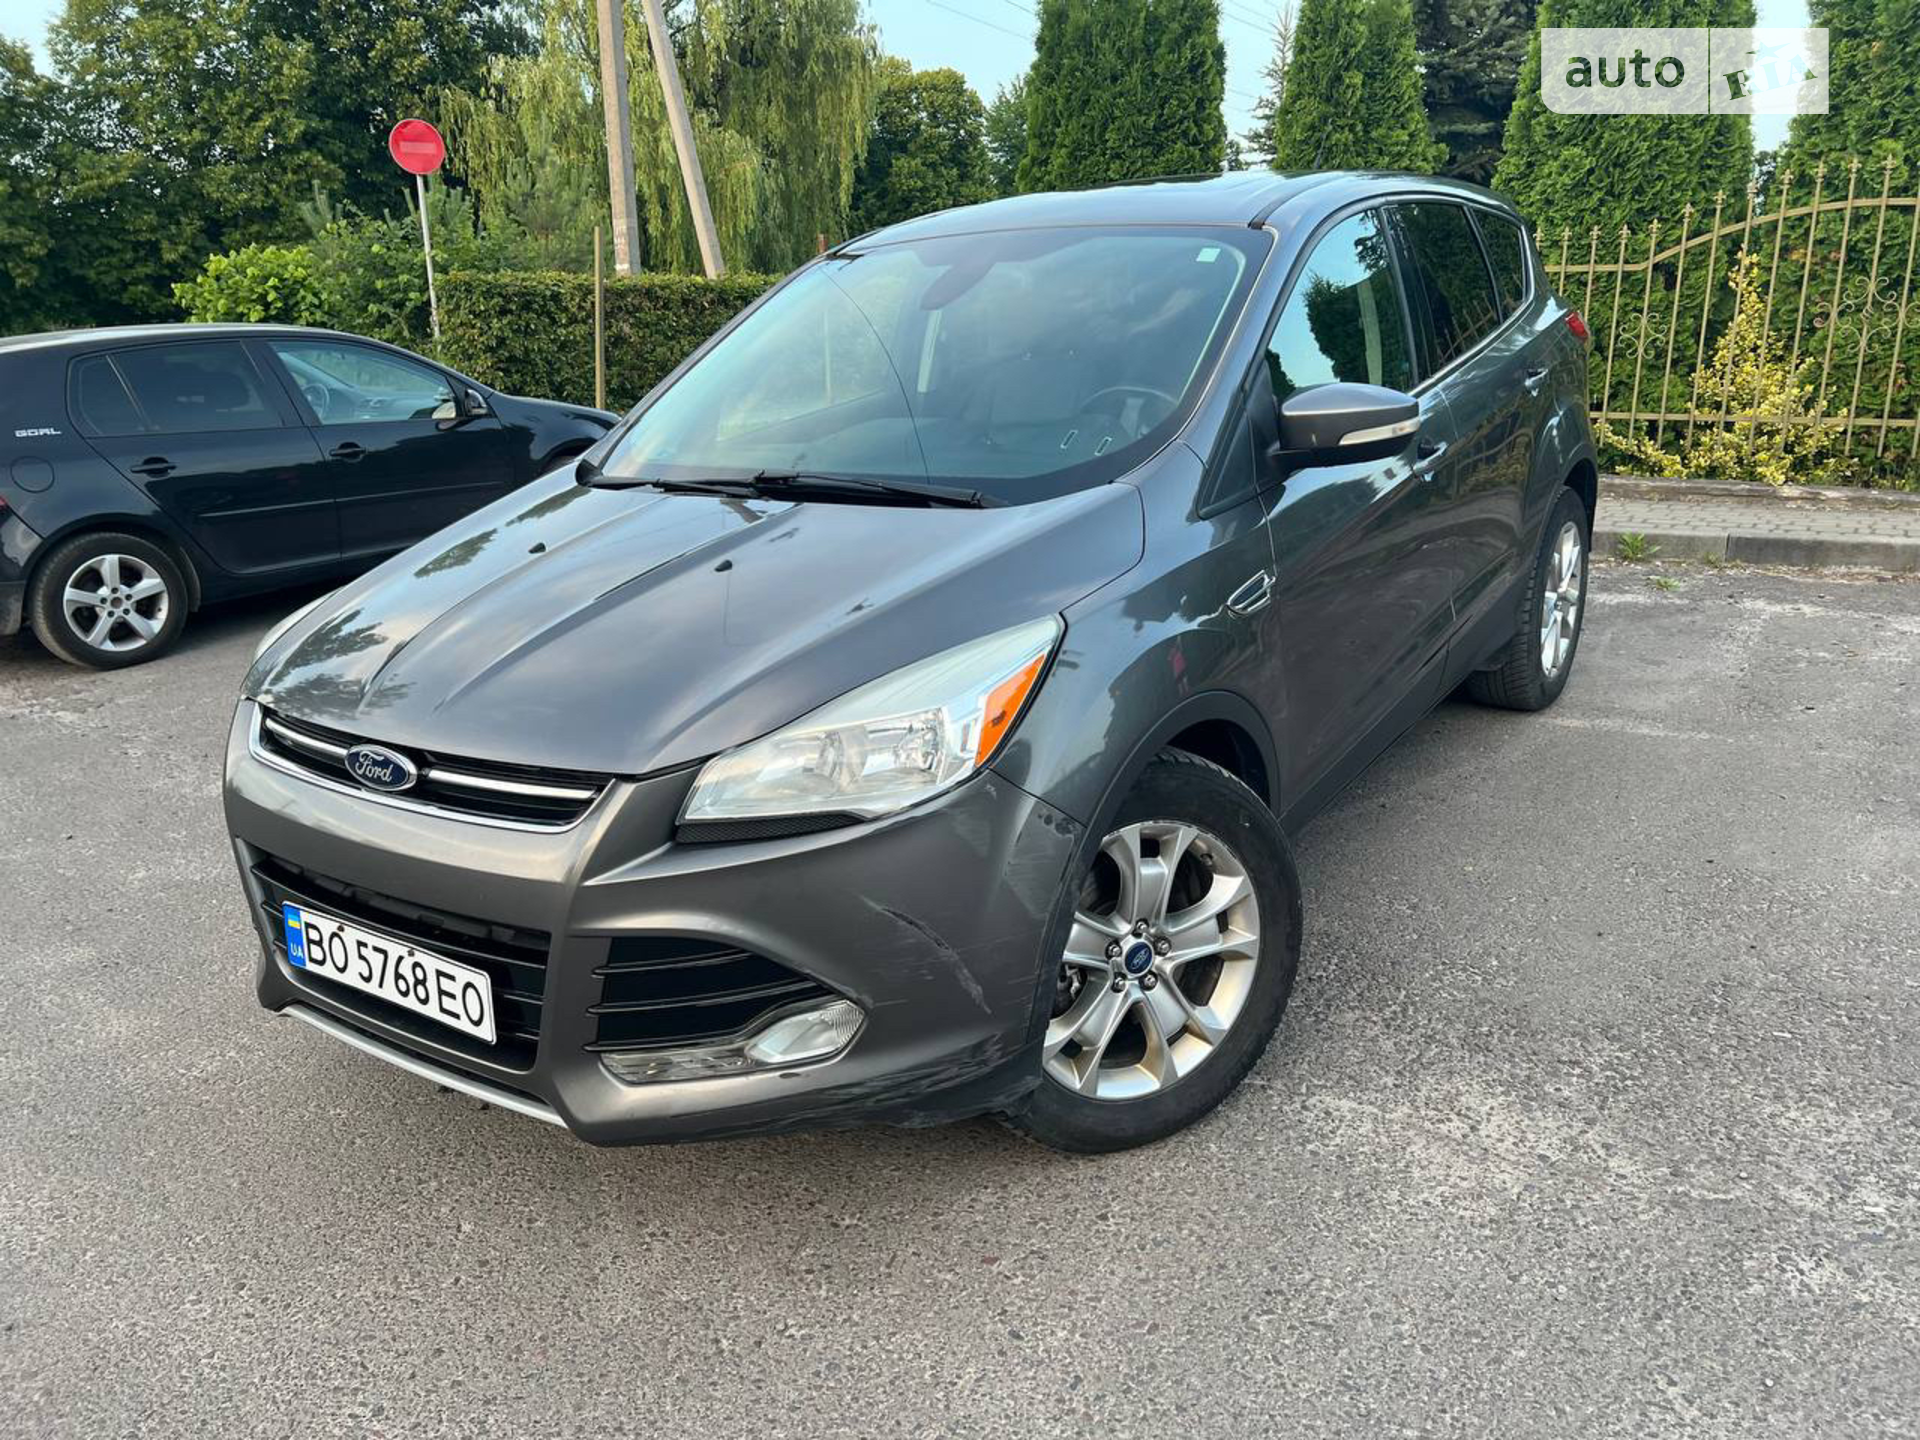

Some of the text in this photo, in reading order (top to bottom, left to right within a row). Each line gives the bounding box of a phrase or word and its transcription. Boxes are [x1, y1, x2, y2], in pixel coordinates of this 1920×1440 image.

[355, 750, 394, 782] Ford
[356, 939, 430, 1006] 5768
[435, 968, 484, 1028] EO
